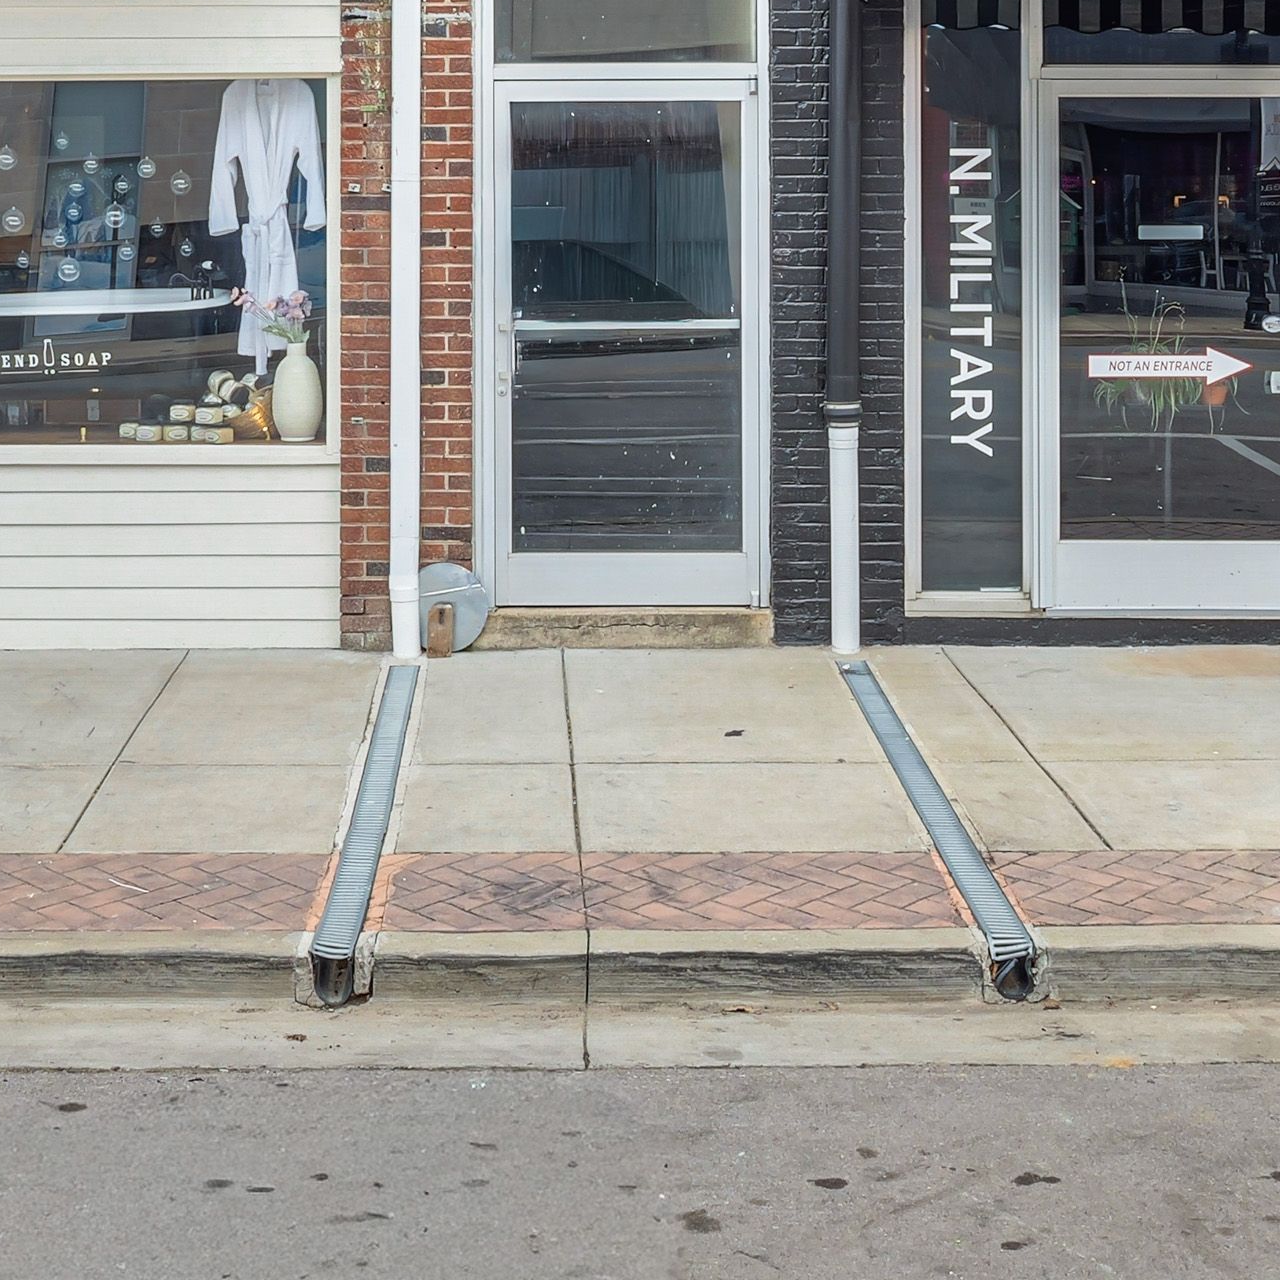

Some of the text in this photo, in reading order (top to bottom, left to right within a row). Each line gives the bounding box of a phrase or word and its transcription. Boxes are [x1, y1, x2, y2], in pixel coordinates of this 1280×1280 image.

[949, 214, 995, 458] MILITARY
[60, 352, 112, 367] SOAP
[1108, 360, 1213, 372] NOT AN ENTRANCE
